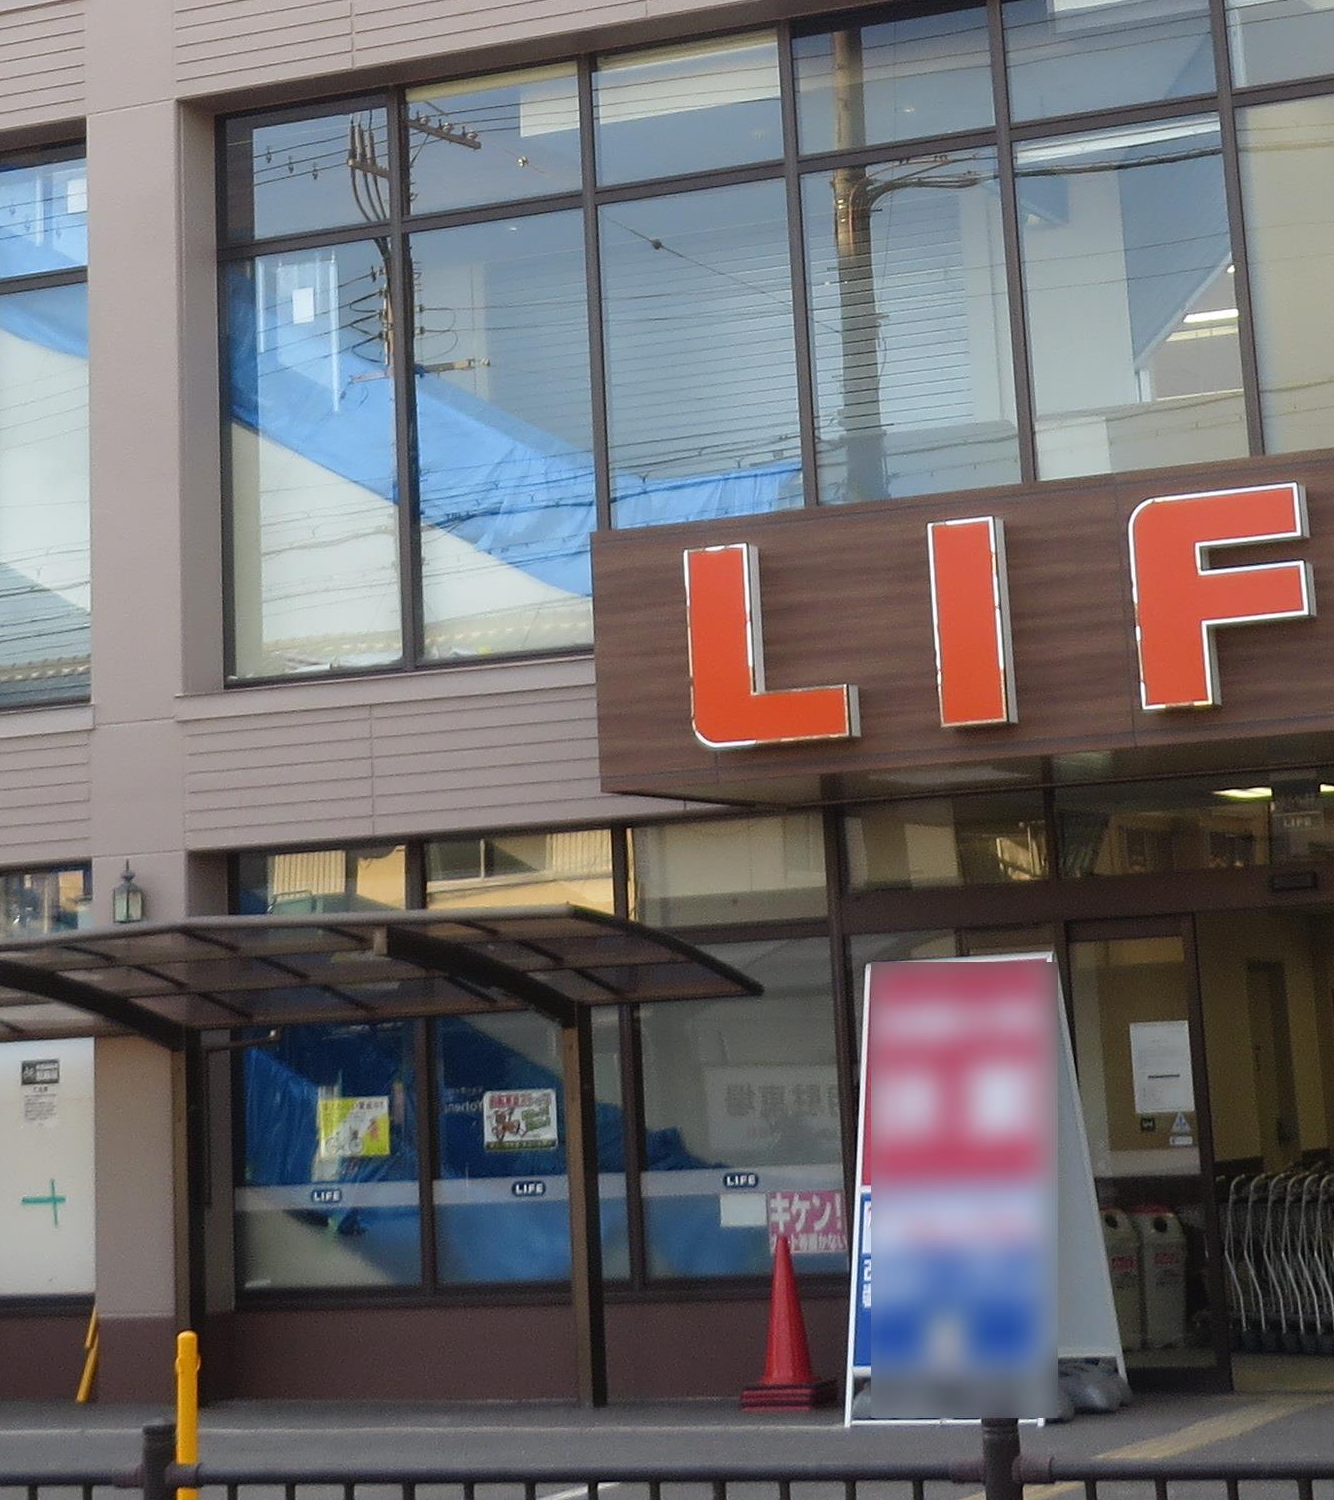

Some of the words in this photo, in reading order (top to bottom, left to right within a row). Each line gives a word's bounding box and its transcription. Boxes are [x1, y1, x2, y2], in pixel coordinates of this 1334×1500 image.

[726, 1174, 756, 1186] LIFE
[515, 1183, 544, 1195] LIFE
[313, 1191, 340, 1202] LIFE
